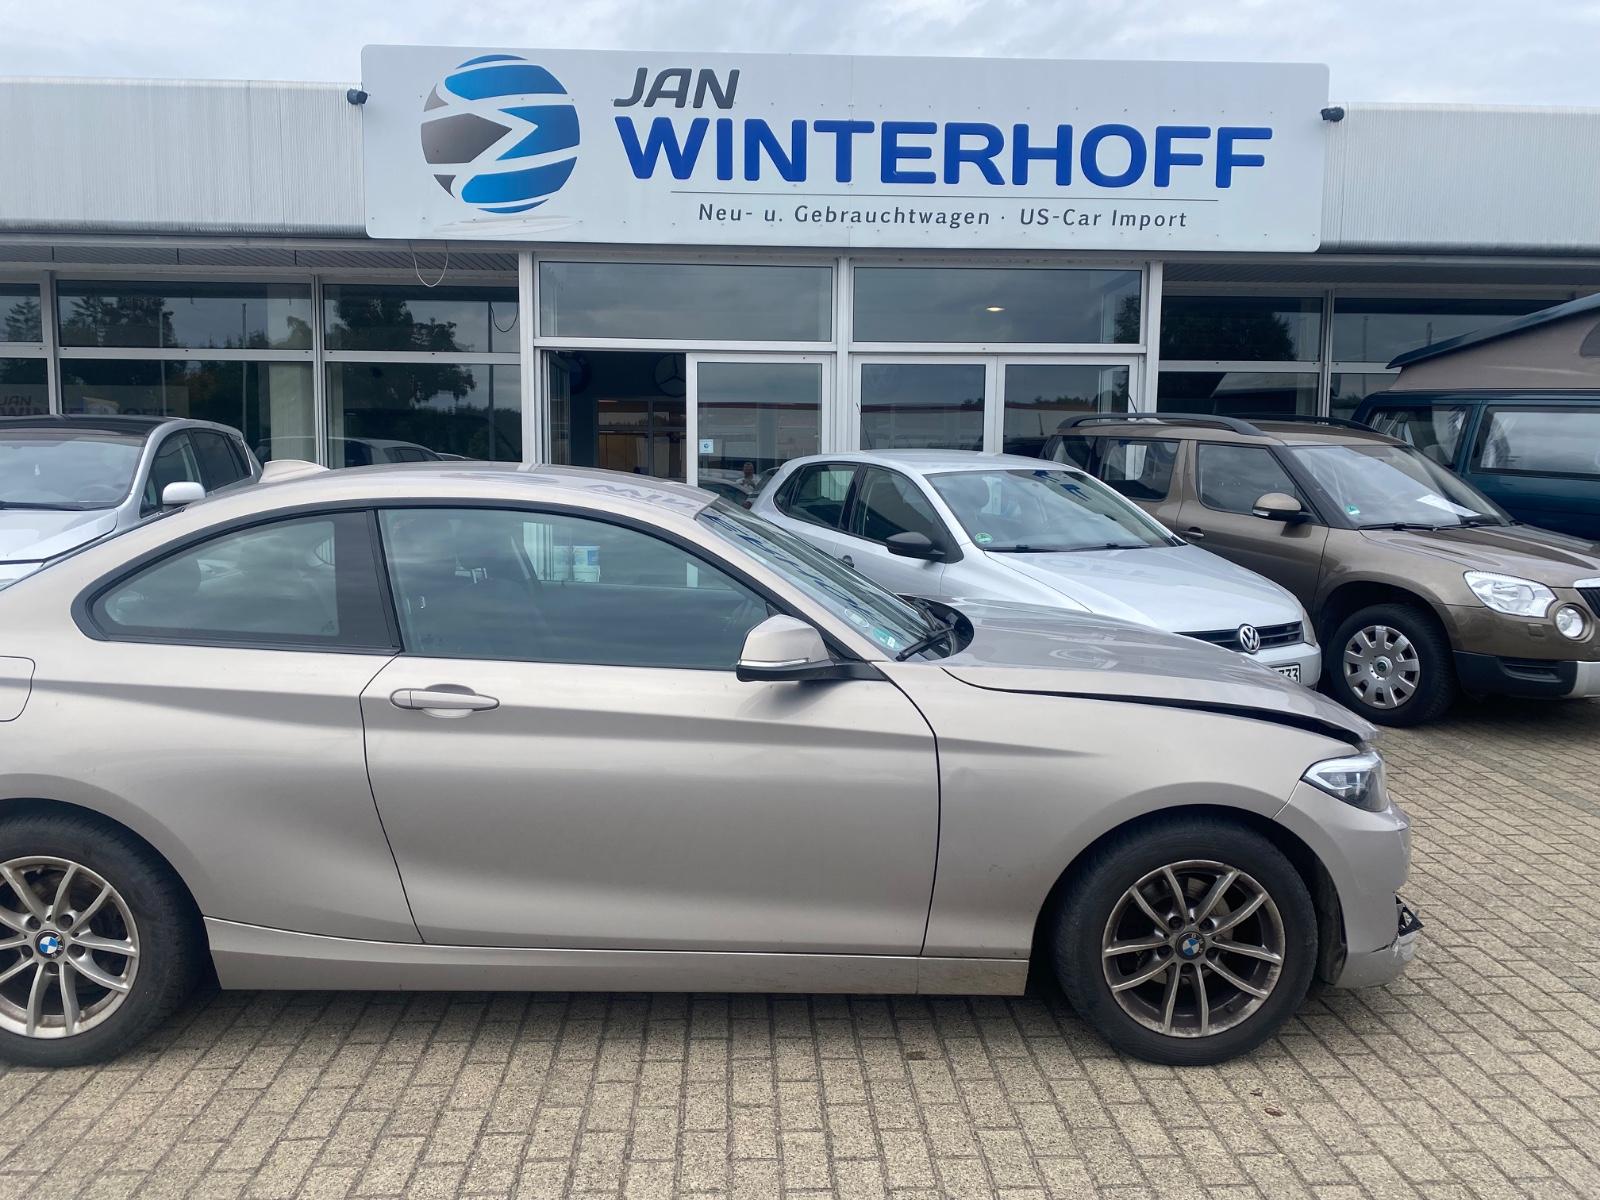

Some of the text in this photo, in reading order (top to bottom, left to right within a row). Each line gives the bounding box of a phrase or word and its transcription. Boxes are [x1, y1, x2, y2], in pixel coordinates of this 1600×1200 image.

[613, 67, 740, 110] JAN
[614, 116, 1273, 189] WINTERHOFF
[699, 203, 1188, 231] Neu- u. Gebrauchtwagen US-Car Import
